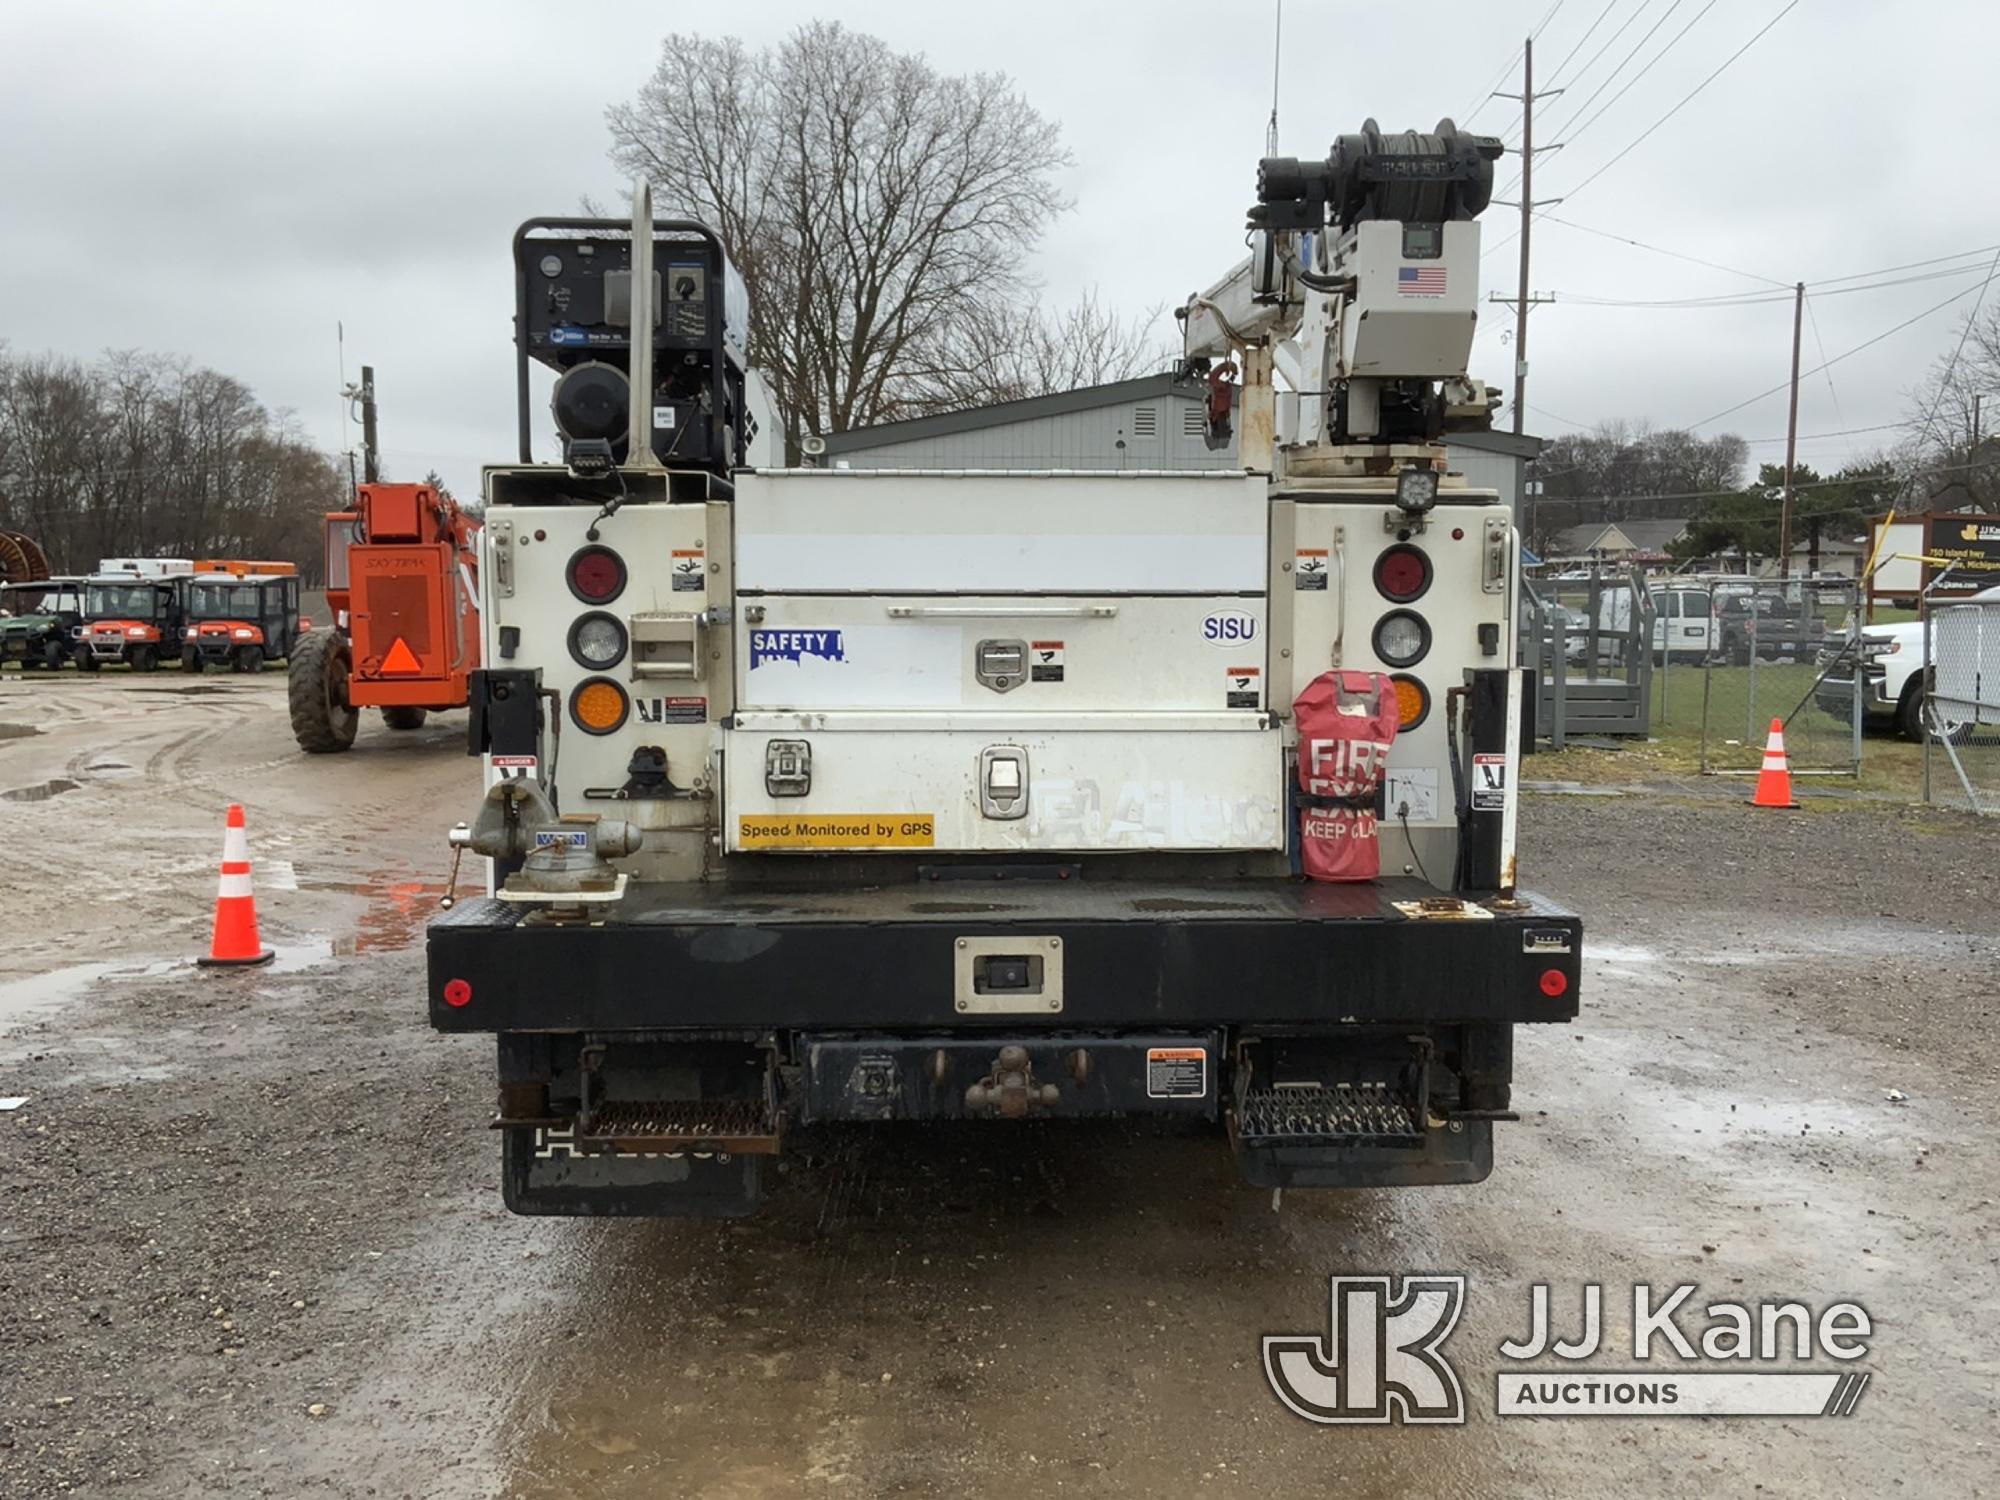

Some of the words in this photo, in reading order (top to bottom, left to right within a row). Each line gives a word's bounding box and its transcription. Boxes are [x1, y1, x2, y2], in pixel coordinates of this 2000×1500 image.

[1204, 617, 1254, 639] SISU
[753, 632, 827, 651] SAFETY
[741, 824, 791, 838] Speed
[796, 823, 870, 836] Monitored
[876, 824, 894, 838] by
[900, 823, 932, 836] GPS
[1305, 820, 1347, 839] KEEP
